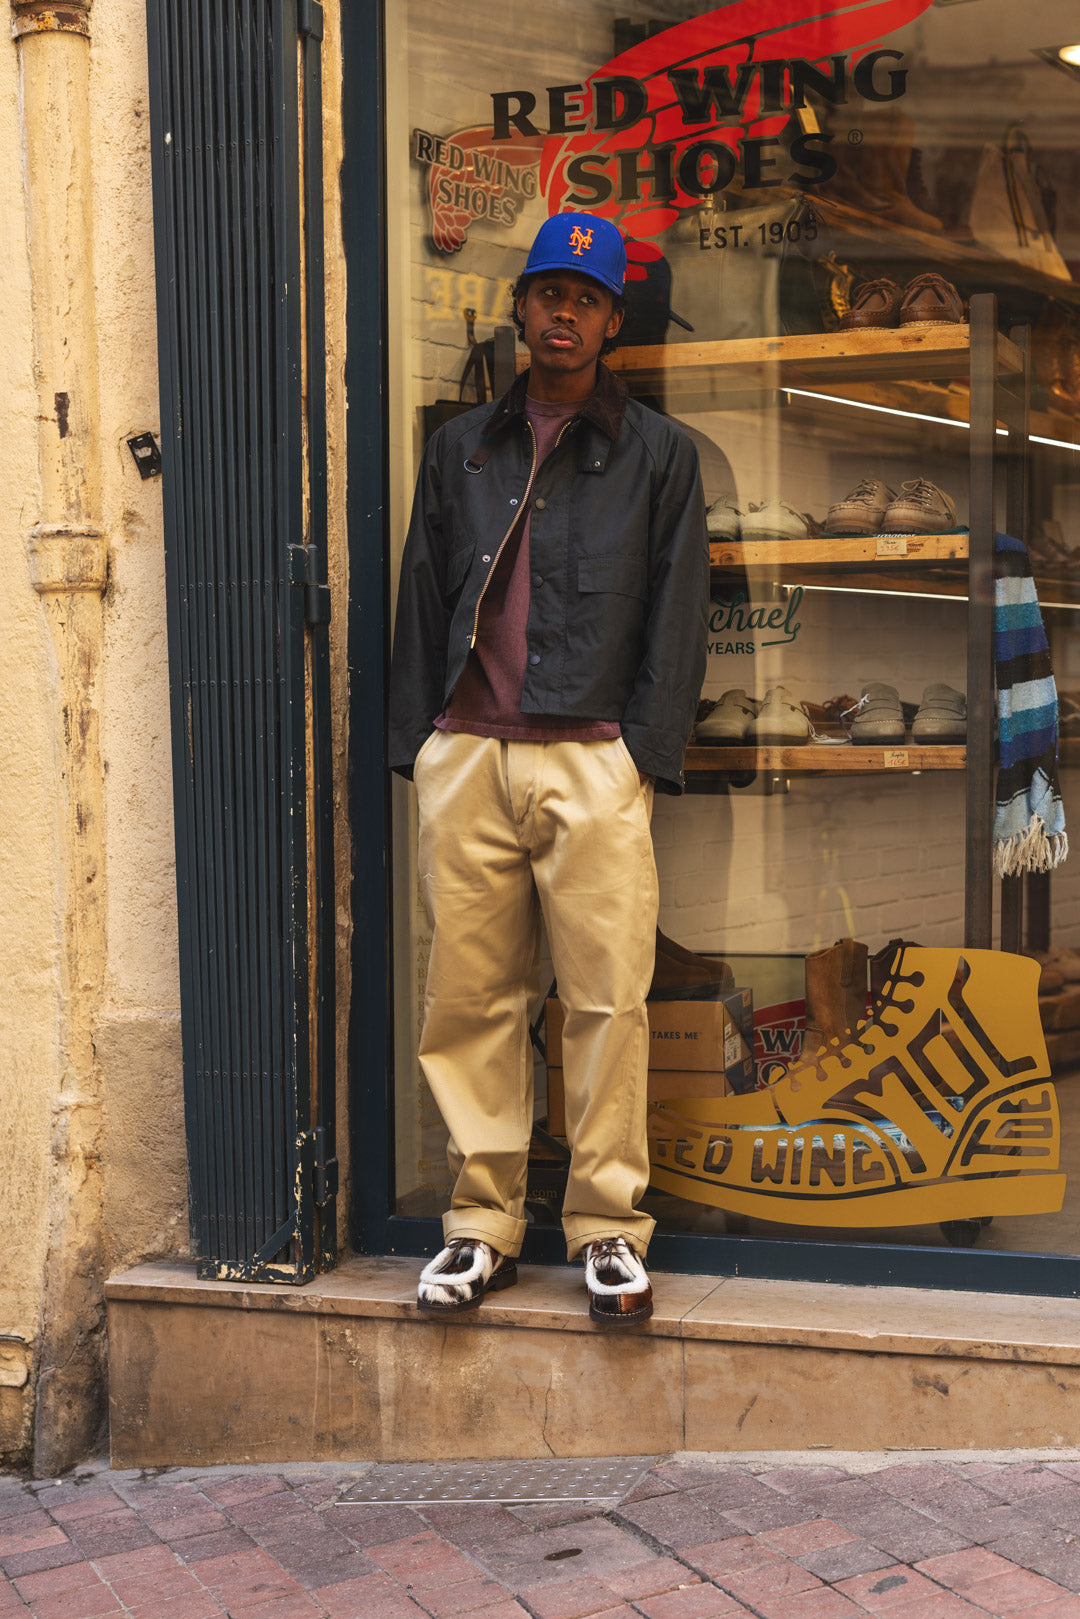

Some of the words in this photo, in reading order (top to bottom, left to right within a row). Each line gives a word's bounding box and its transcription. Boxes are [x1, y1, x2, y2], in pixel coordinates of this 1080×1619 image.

[490, 79, 646, 140] RED
[667, 49, 909, 123] WING
[416, 132, 464, 171] RED
[472, 152, 537, 197] WING
[564, 132, 838, 205] SHOES
[437, 177, 517, 225] SHOES
[700, 224, 748, 250] EST.
[758, 219, 818, 246] 1905
[706, 641, 755, 655] YEARS
[651, 1031, 680, 1040] TAKES
[960, 1089, 1053, 1167] TOE
[751, 1134, 886, 1187] WING
